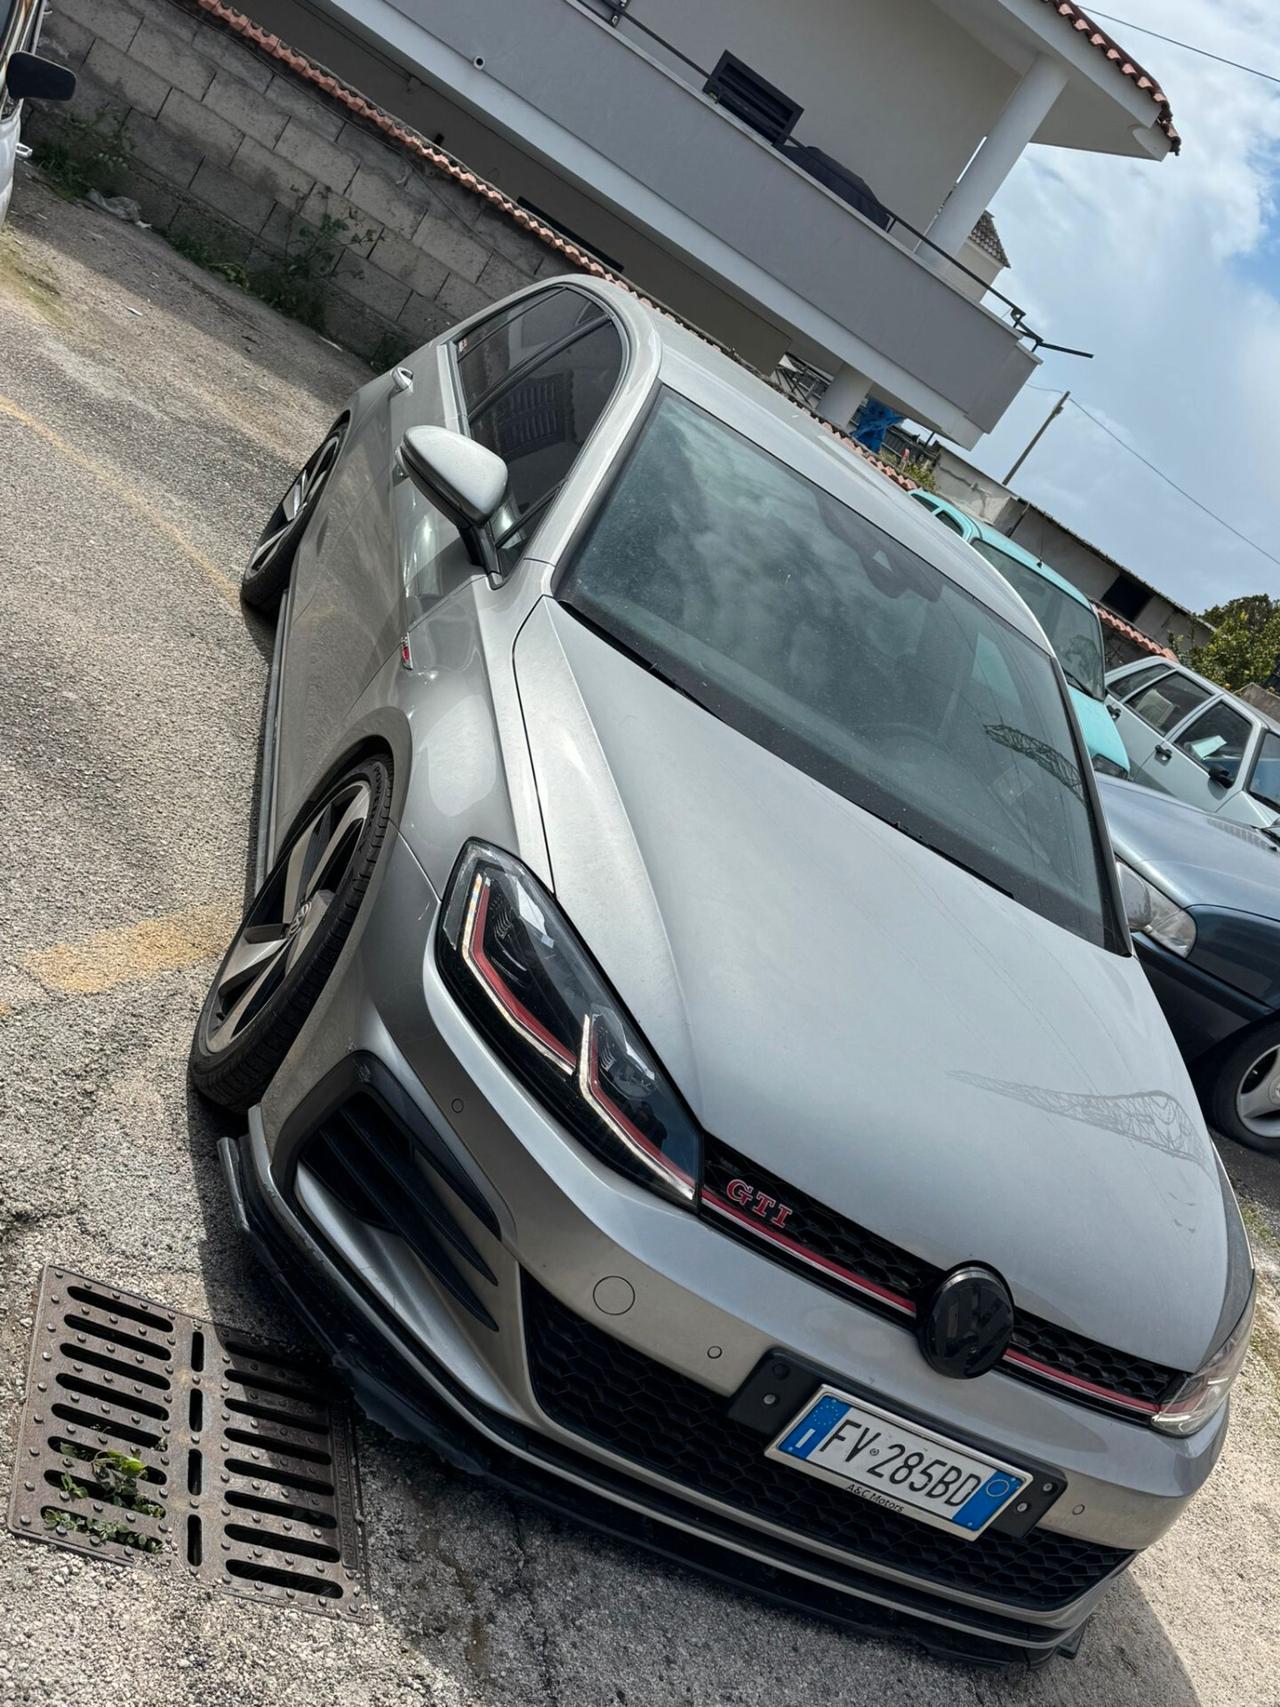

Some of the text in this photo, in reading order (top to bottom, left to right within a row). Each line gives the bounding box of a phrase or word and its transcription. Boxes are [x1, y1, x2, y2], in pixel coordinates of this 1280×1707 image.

[726, 1178, 793, 1229] GTI
[846, 1483, 905, 1513] A&C Motors
